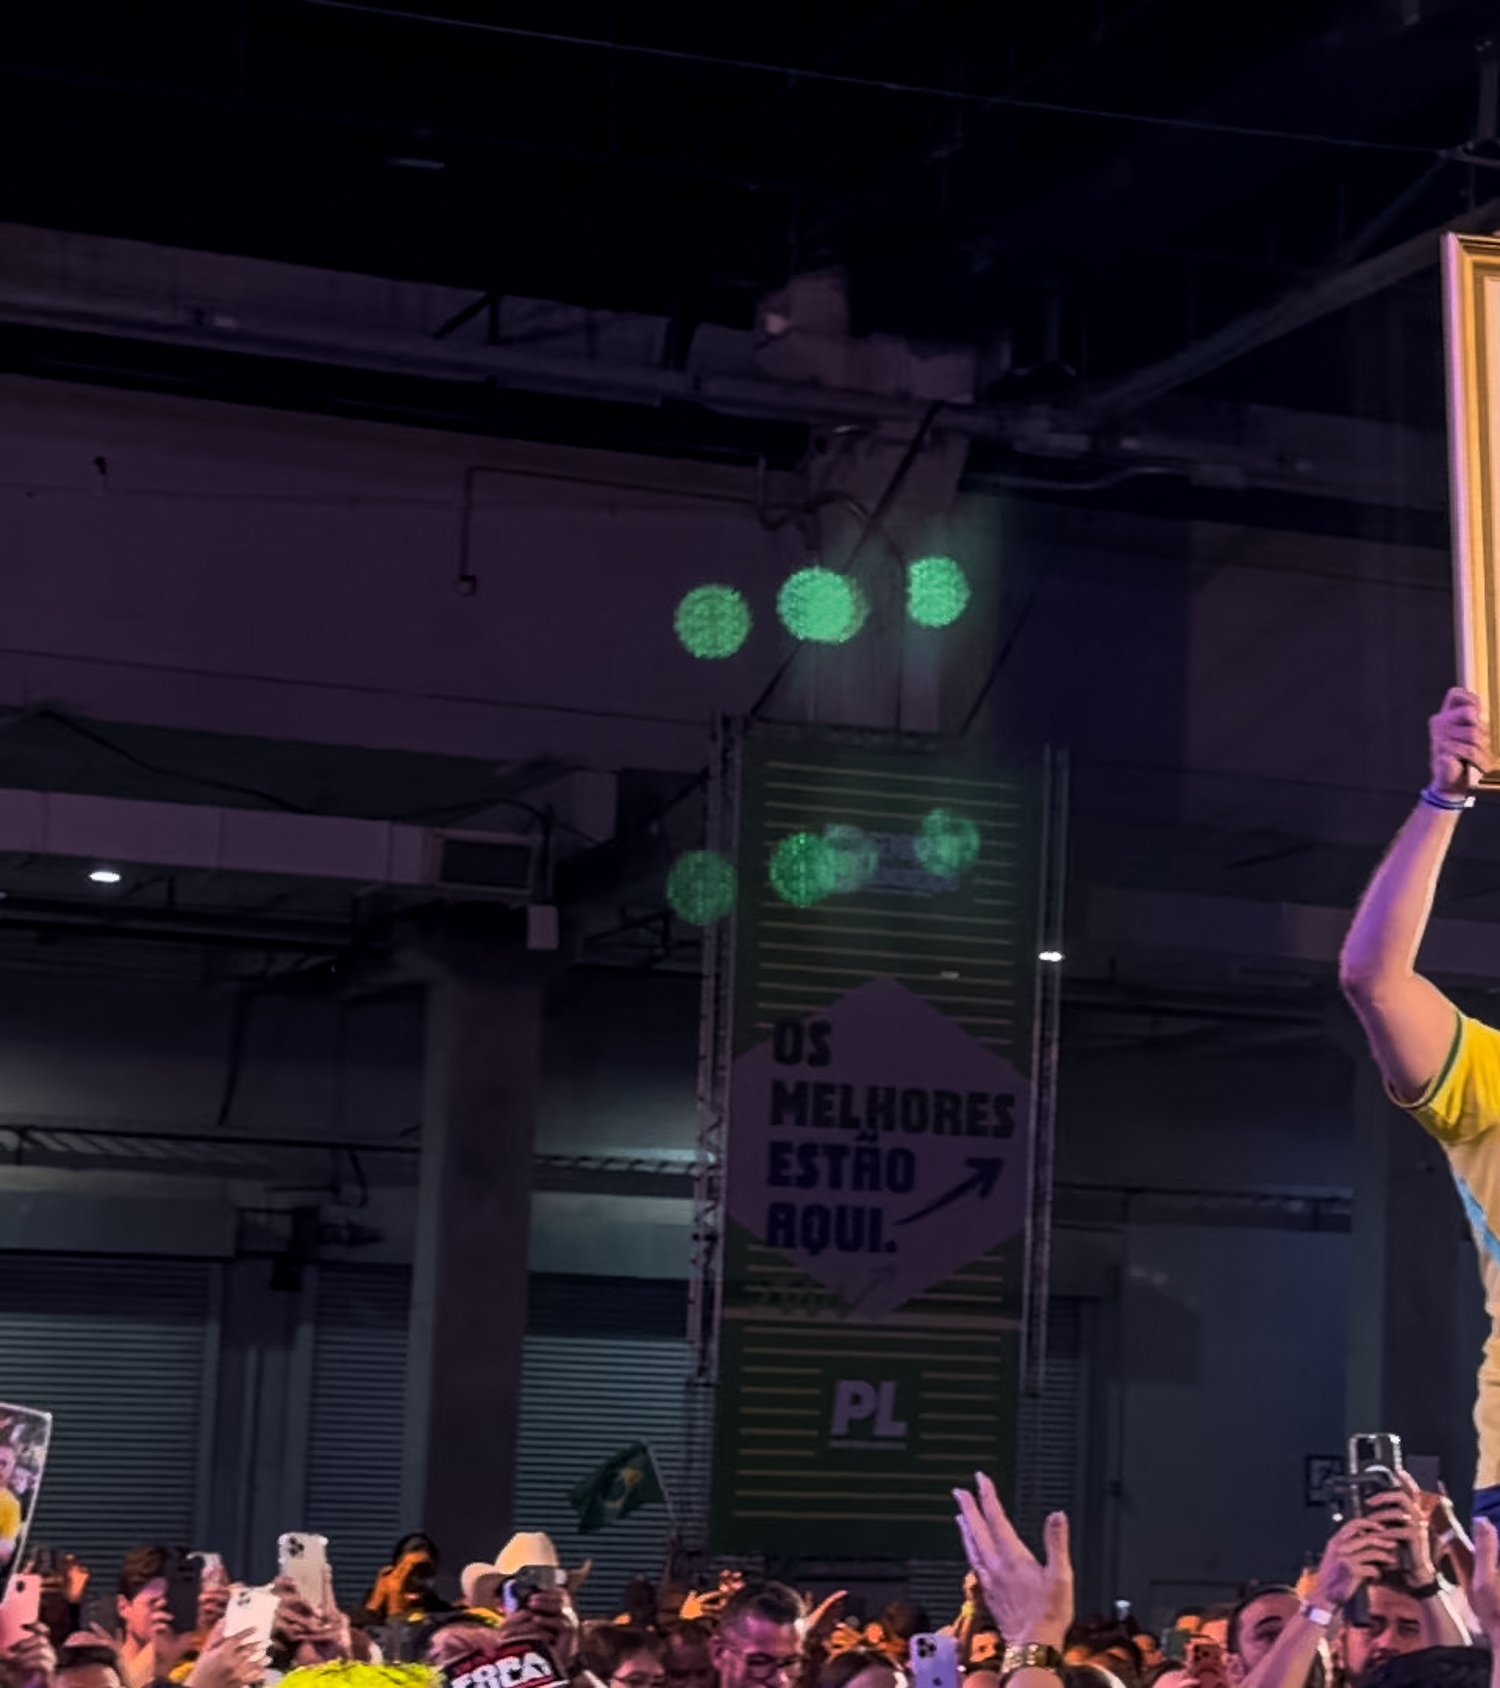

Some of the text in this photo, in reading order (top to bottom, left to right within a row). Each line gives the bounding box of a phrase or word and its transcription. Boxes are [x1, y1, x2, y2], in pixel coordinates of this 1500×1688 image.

[773, 1017, 831, 1067] OS
[770, 1078, 1016, 1138] MELHORES
[767, 1130, 915, 1193] ESTÃO
[766, 1202, 898, 1256] AQUI.
[829, 1378, 908, 1437] PL
